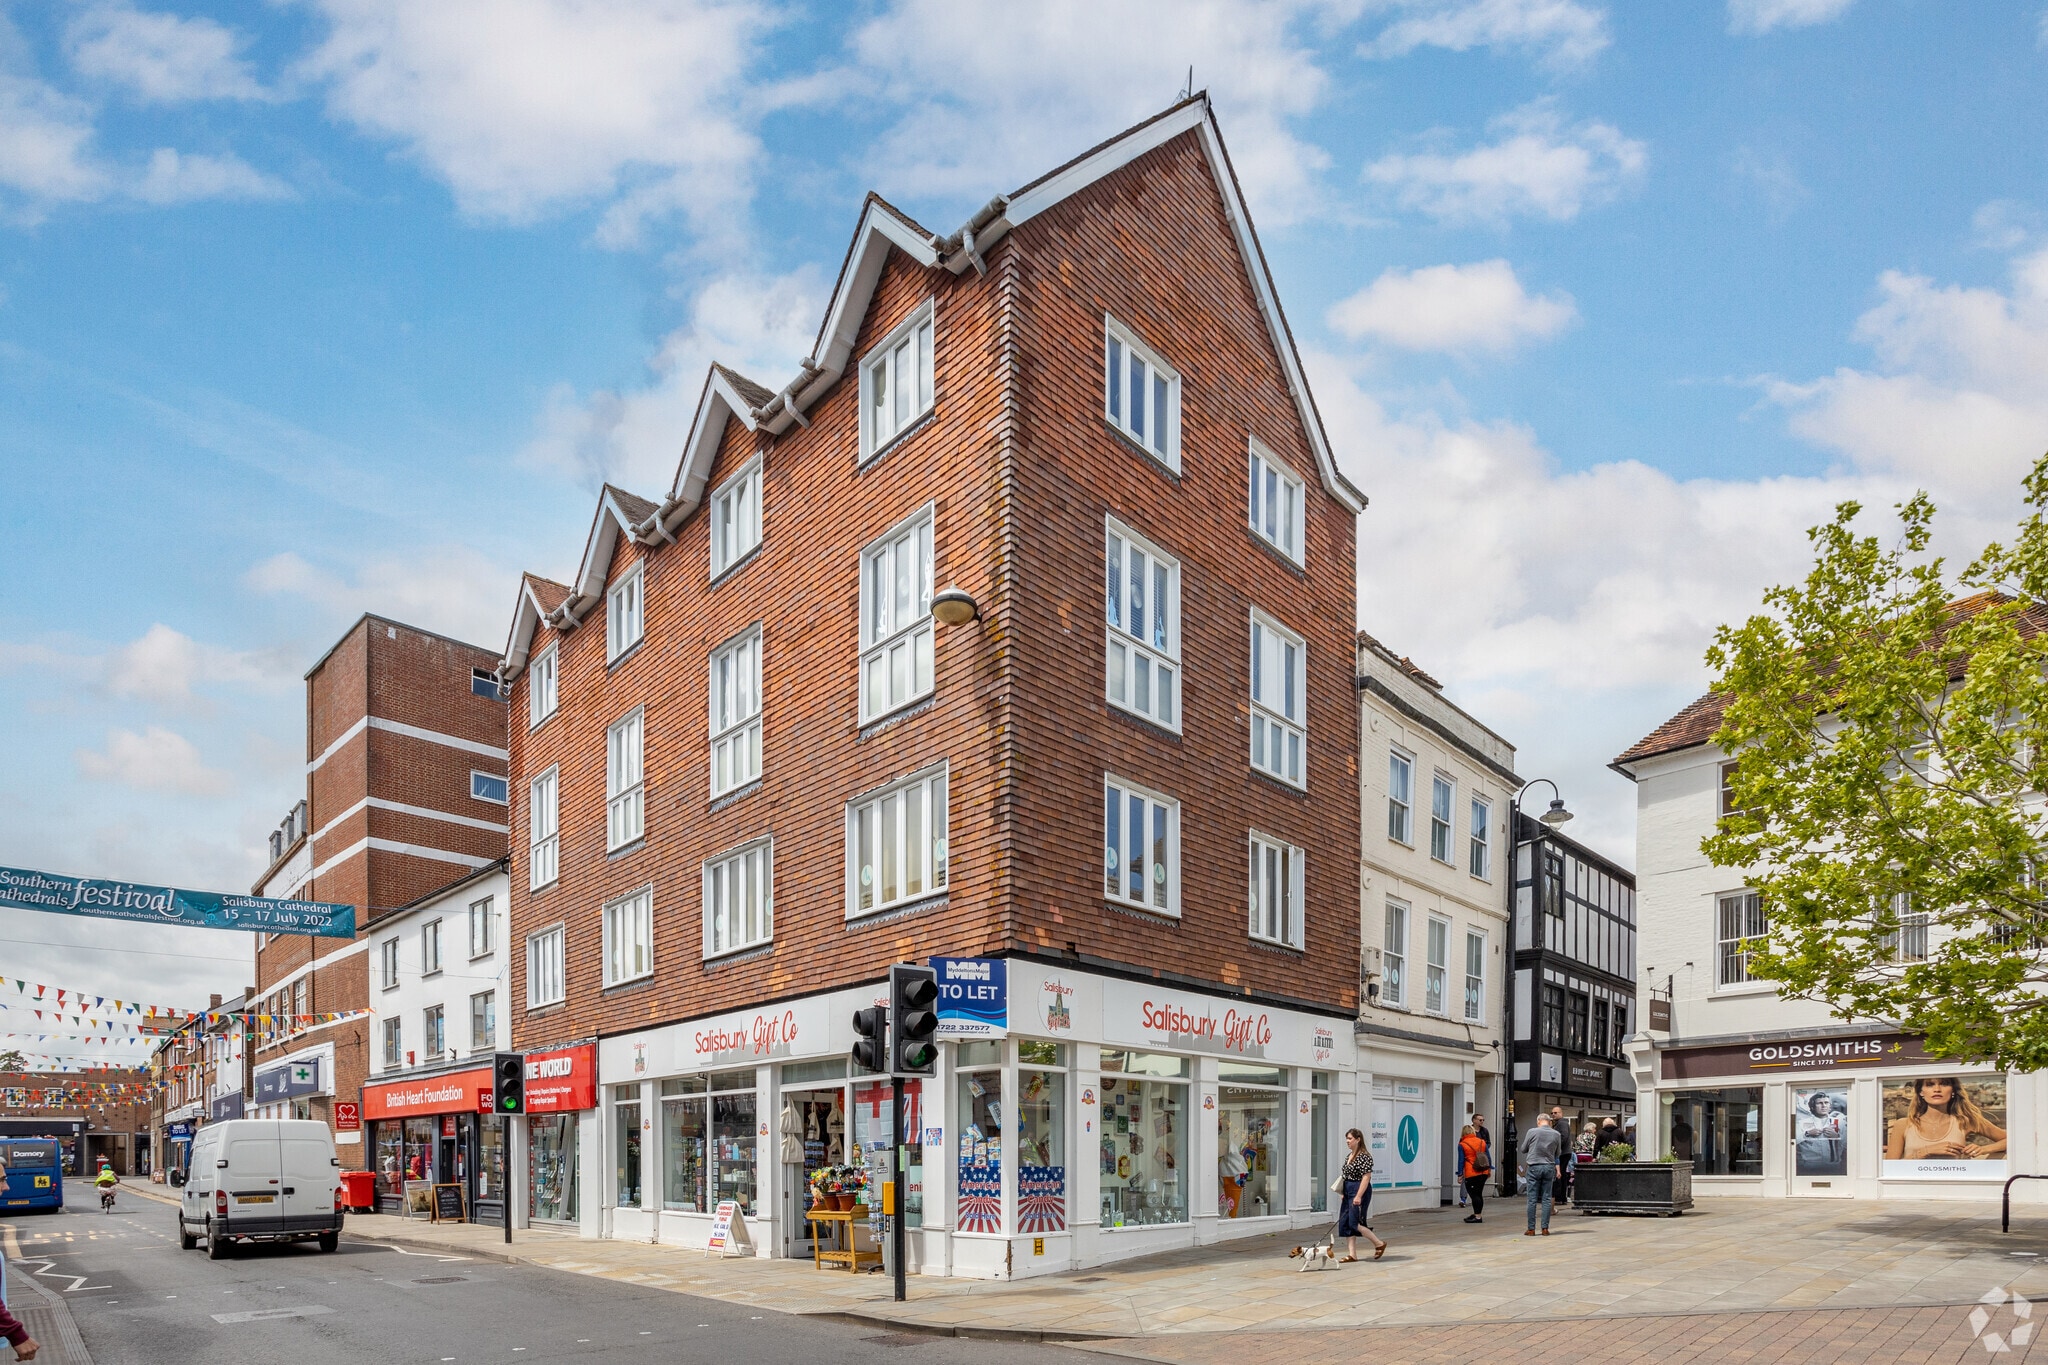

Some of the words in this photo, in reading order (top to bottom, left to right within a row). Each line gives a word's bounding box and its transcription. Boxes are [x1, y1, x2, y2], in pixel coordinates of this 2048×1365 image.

[0, 870, 72, 891] Southern
[67, 879, 184, 916] festival
[222, 896, 274, 911] Salisbury
[277, 900, 332, 914] Cathedral
[223, 908, 239, 920] 15
[255, 910, 271, 921] 17
[274, 912, 300, 925] July
[303, 914, 333, 926] 2022
[237, 922, 321, 934] salisburycathedral.org.uk
[939, 984, 963, 999] TO
[967, 985, 998, 1000] LET
[1044, 981, 1074, 996] Salisbury
[695, 1028, 748, 1054] Salisbury
[752, 1015, 779, 1055] Gift
[782, 1010, 799, 1043] Co
[1142, 1001, 1217, 1041] Salisbury
[1224, 1008, 1254, 1052] Gift
[1256, 1014, 1272, 1045] Co
[1749, 1040, 1882, 1060] GOLDSMITHS
[540, 1057, 572, 1078] WORLD
[386, 1092, 406, 1108] British
[406, 1090, 424, 1105] Heart
[424, 1085, 463, 1103] Foundation
[961, 1180, 1001, 1190] American
[1021, 1180, 1061, 1190] American
[967, 1195, 994, 1205] Candy
[1027, 1195, 1054, 1205] Candy
[981, 1212, 997, 1220] Here
[1042, 1211, 1057, 1219] Here
